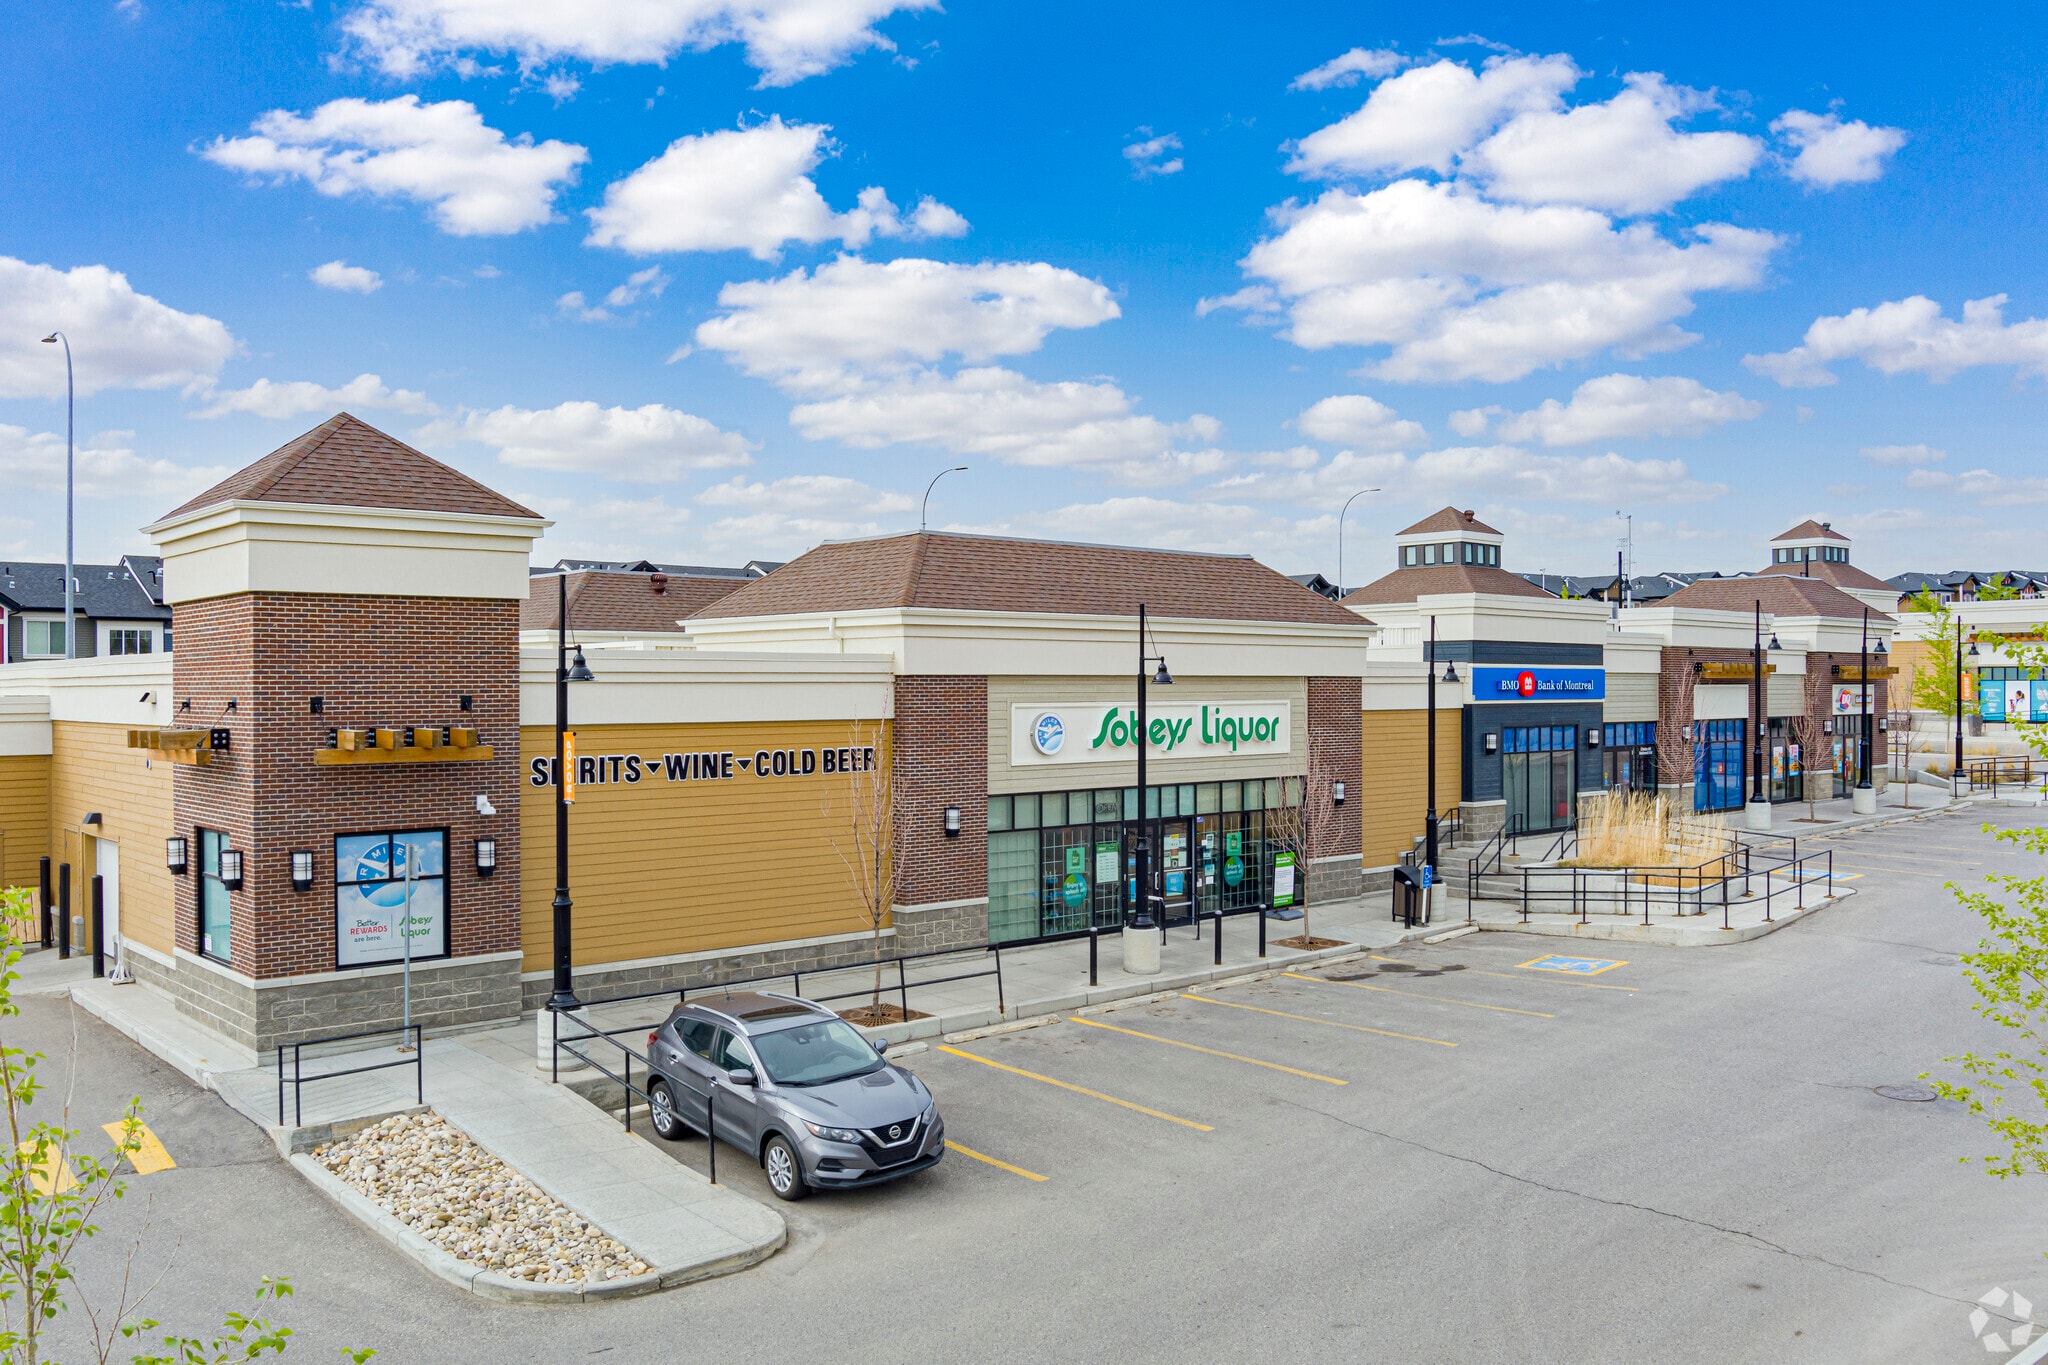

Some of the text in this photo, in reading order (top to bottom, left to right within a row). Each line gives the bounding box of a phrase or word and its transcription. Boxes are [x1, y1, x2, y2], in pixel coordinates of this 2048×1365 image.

[1501, 679, 1594, 690] BMO Bank of Montreal
[1092, 705, 1280, 752] Sobeys Liquor
[530, 746, 877, 787] SRITS WINE COLD BEER
[371, 846, 405, 859] MIE
[398, 915, 434, 927] Sbeys
[350, 925, 388, 935] REWARDS
[400, 927, 432, 939] Lquor
